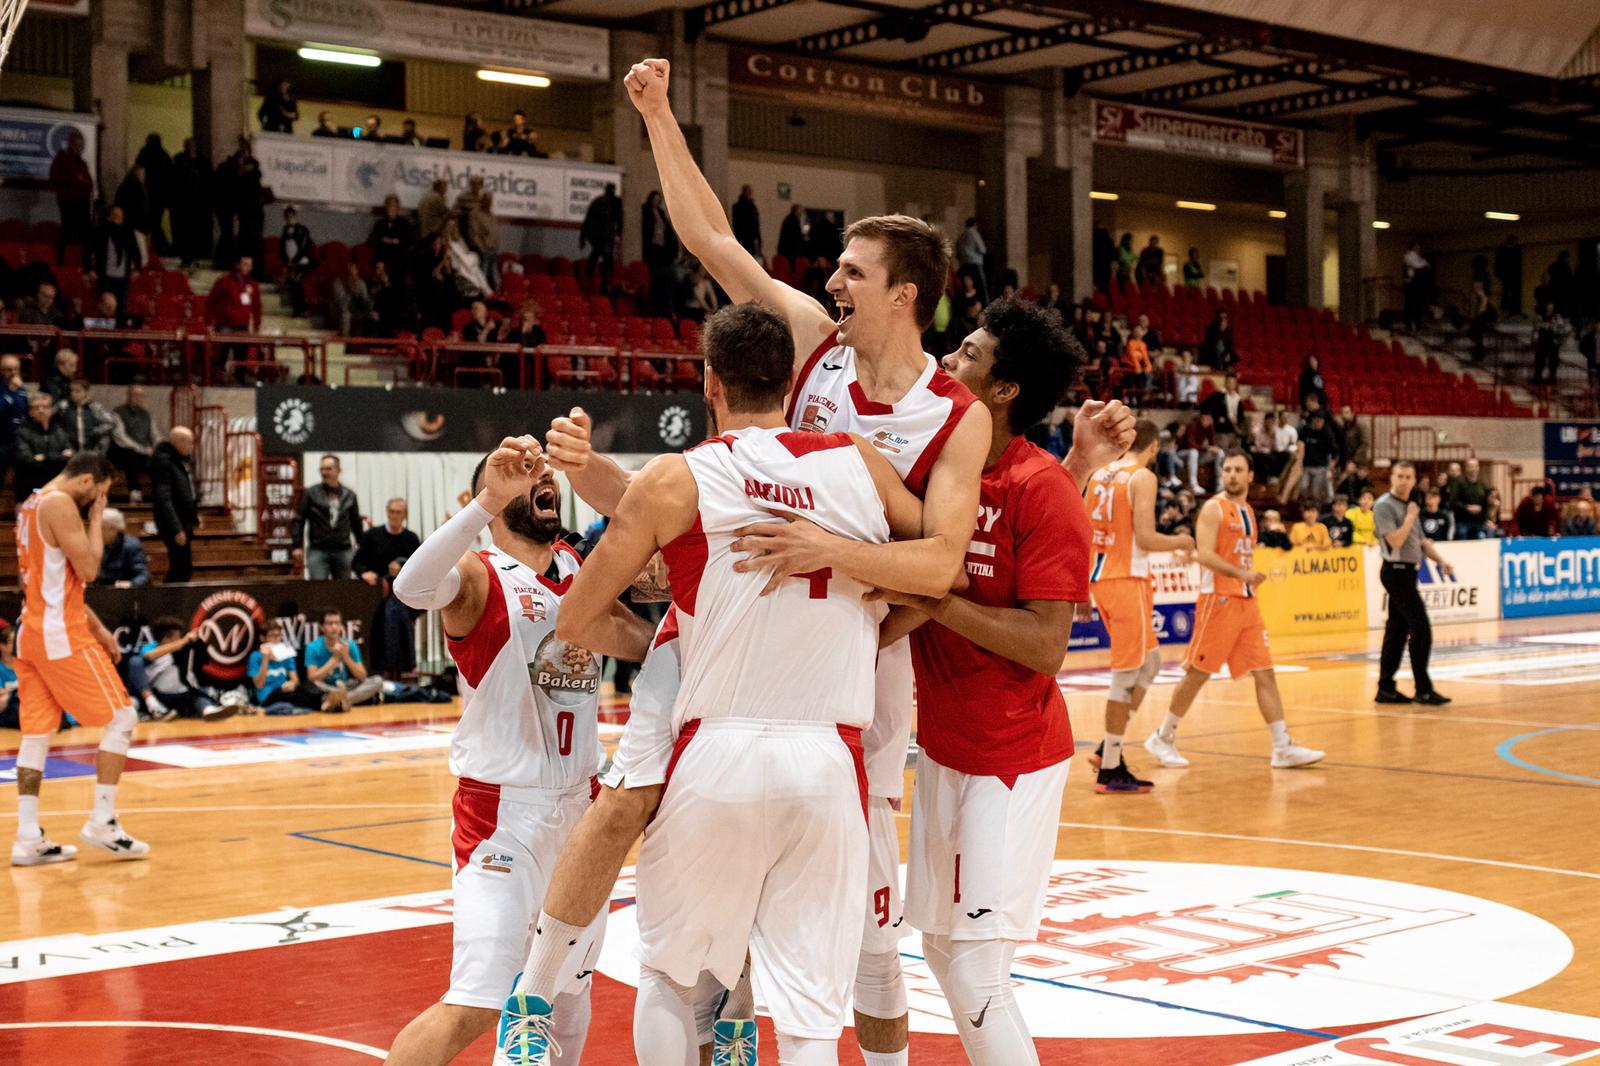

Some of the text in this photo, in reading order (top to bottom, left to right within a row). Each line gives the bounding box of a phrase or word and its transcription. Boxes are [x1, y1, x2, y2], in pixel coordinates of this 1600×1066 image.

[747, 53, 884, 92] Cotton
[901, 75, 984, 106] Club
[1133, 108, 1266, 147] Supermercato
[393, 160, 538, 197] AssiAdiatica
[807, 394, 839, 414] PIACENZA
[1091, 484, 1116, 522] 21
[966, 561, 994, 577] NTINA
[1293, 556, 1358, 575] ALMAUTO
[1422, 586, 1479, 612] ERVICE
[537, 671, 598, 694] Bakery
[556, 711, 575, 756] 0
[874, 885, 890, 928] 9
